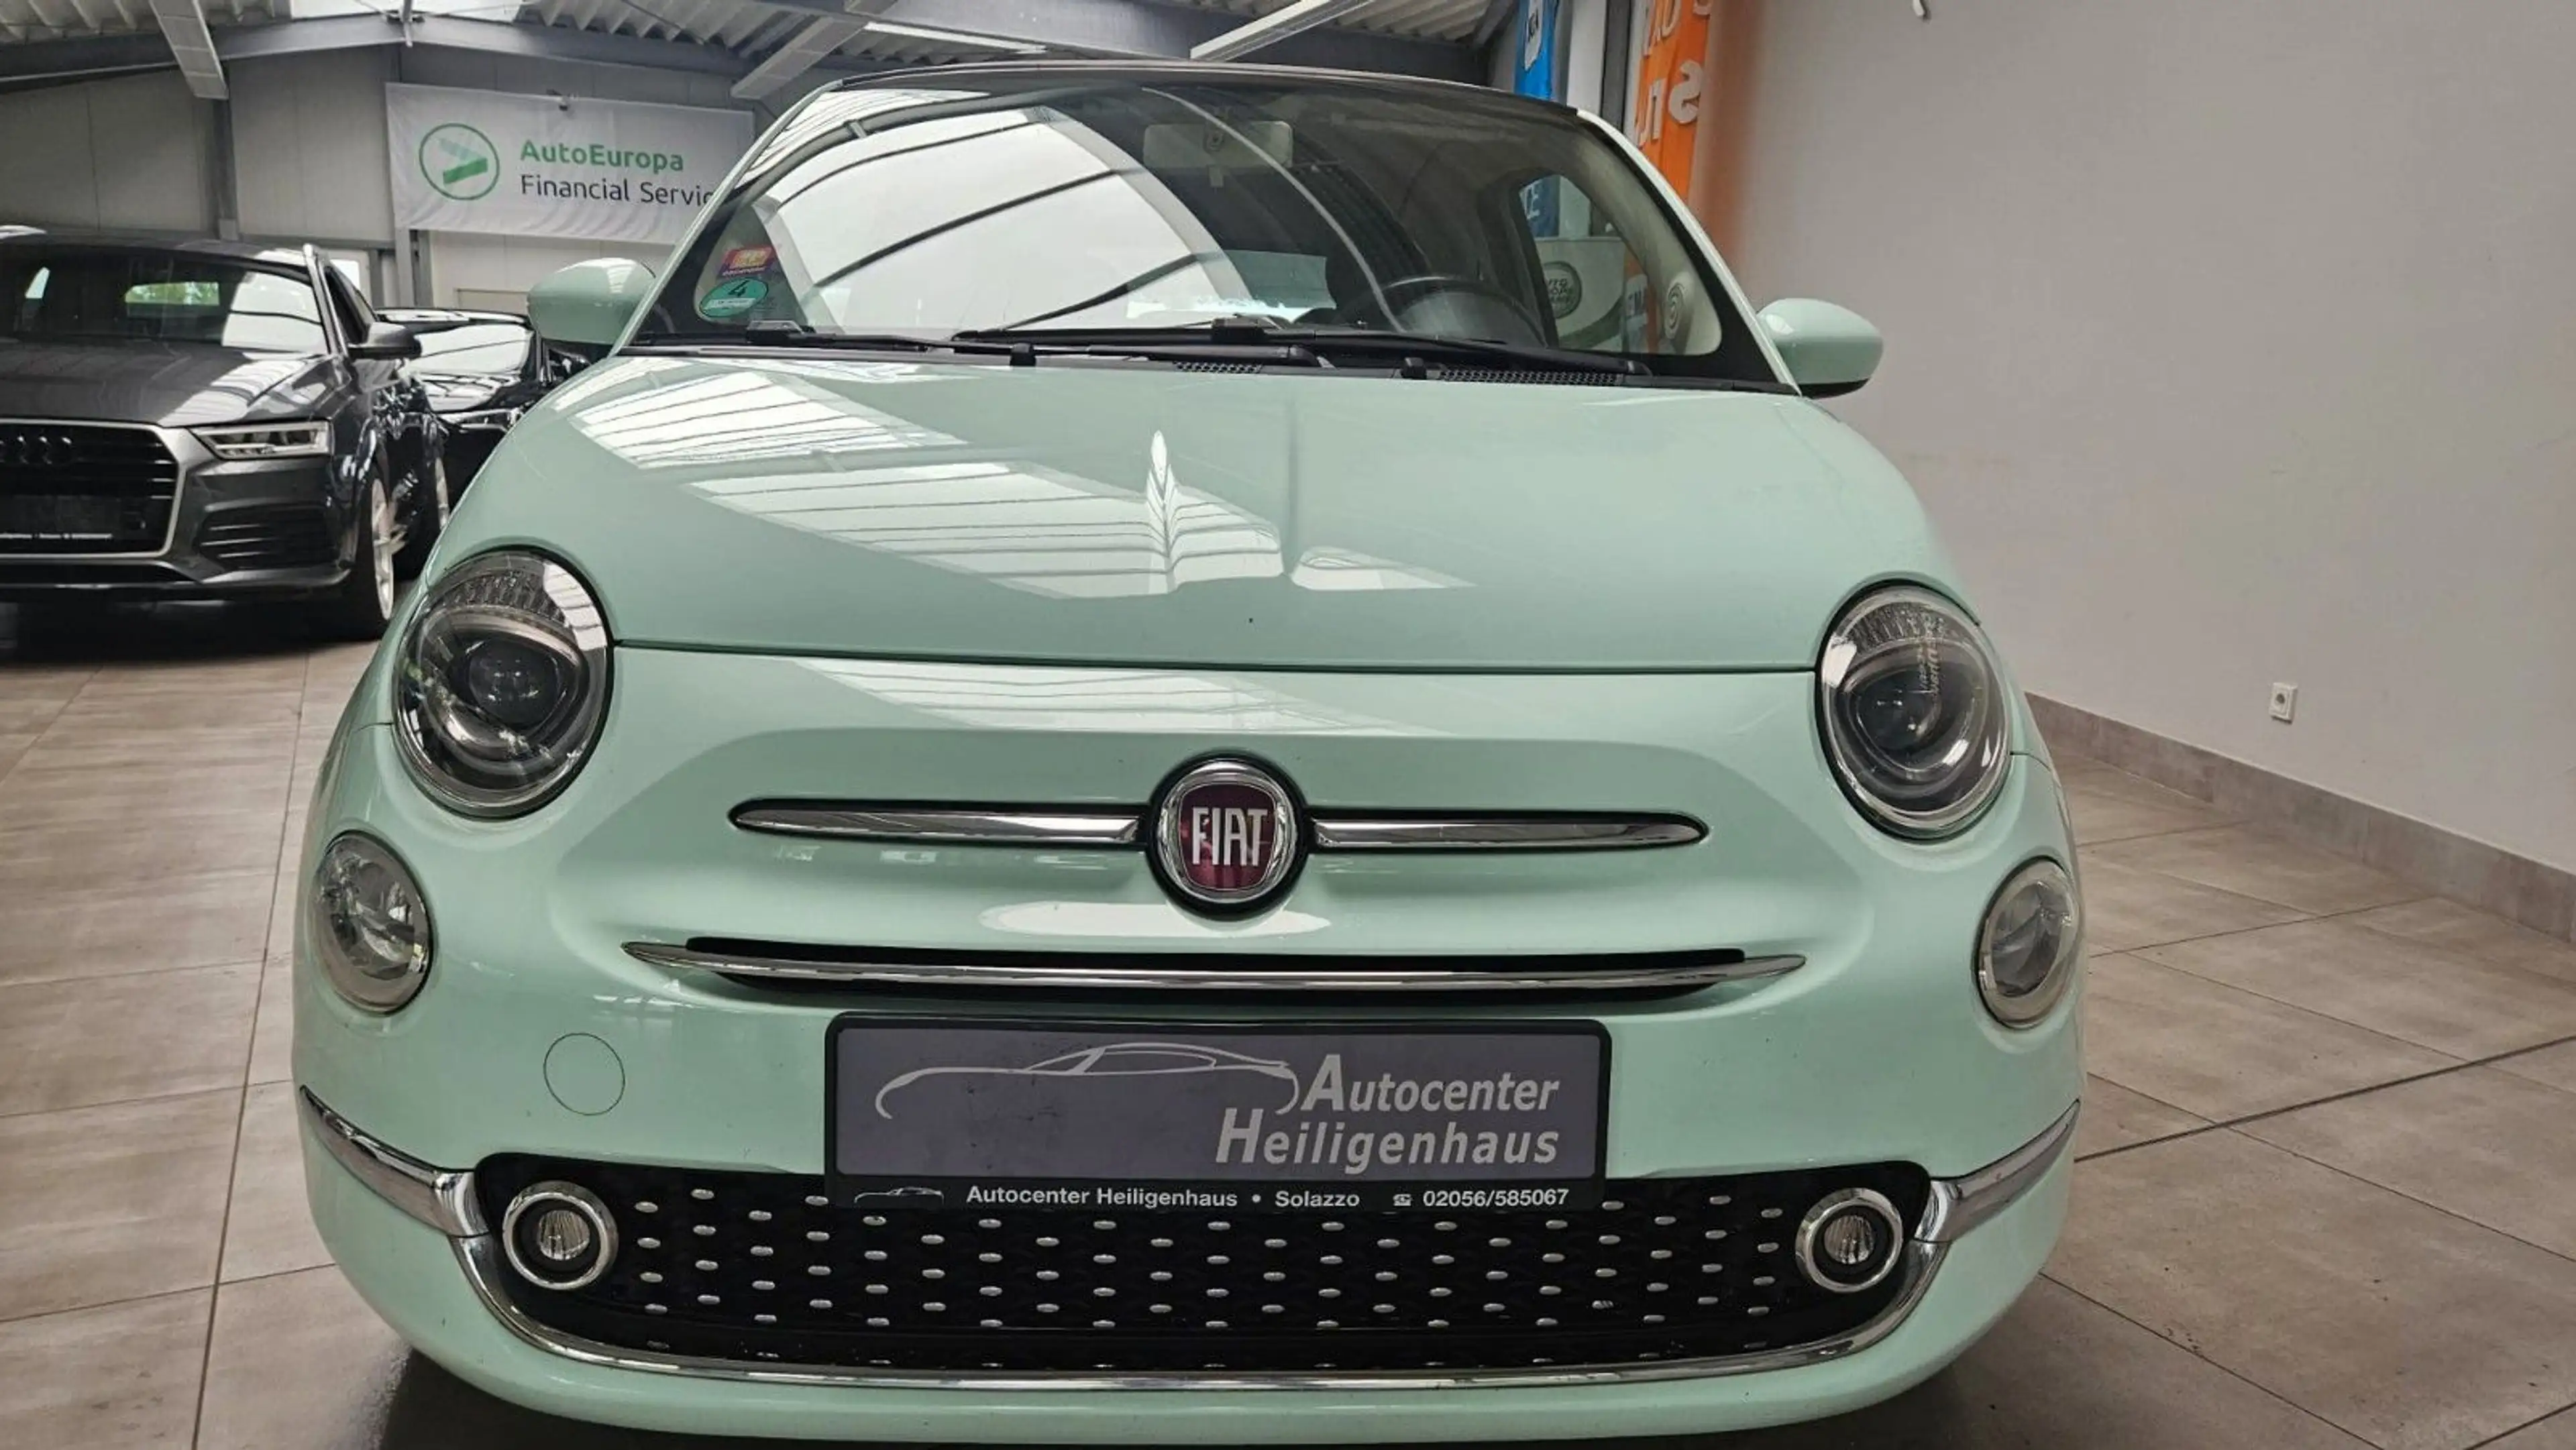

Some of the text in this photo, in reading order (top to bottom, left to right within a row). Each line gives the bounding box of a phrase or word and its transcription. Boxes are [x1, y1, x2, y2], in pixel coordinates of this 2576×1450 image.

[520, 140, 684, 174] AutoEuropa
[521, 174, 629, 201] Financial
[728, 280, 749, 297] 4
[1191, 807, 1268, 867] FIAT
[1300, 1054, 1560, 1113] Autocenter
[1215, 1107, 1559, 1174] Heiligenhaus
[967, 1185, 1570, 1209] Autocenter Heiligenhaus Solazzo 02056/585067
